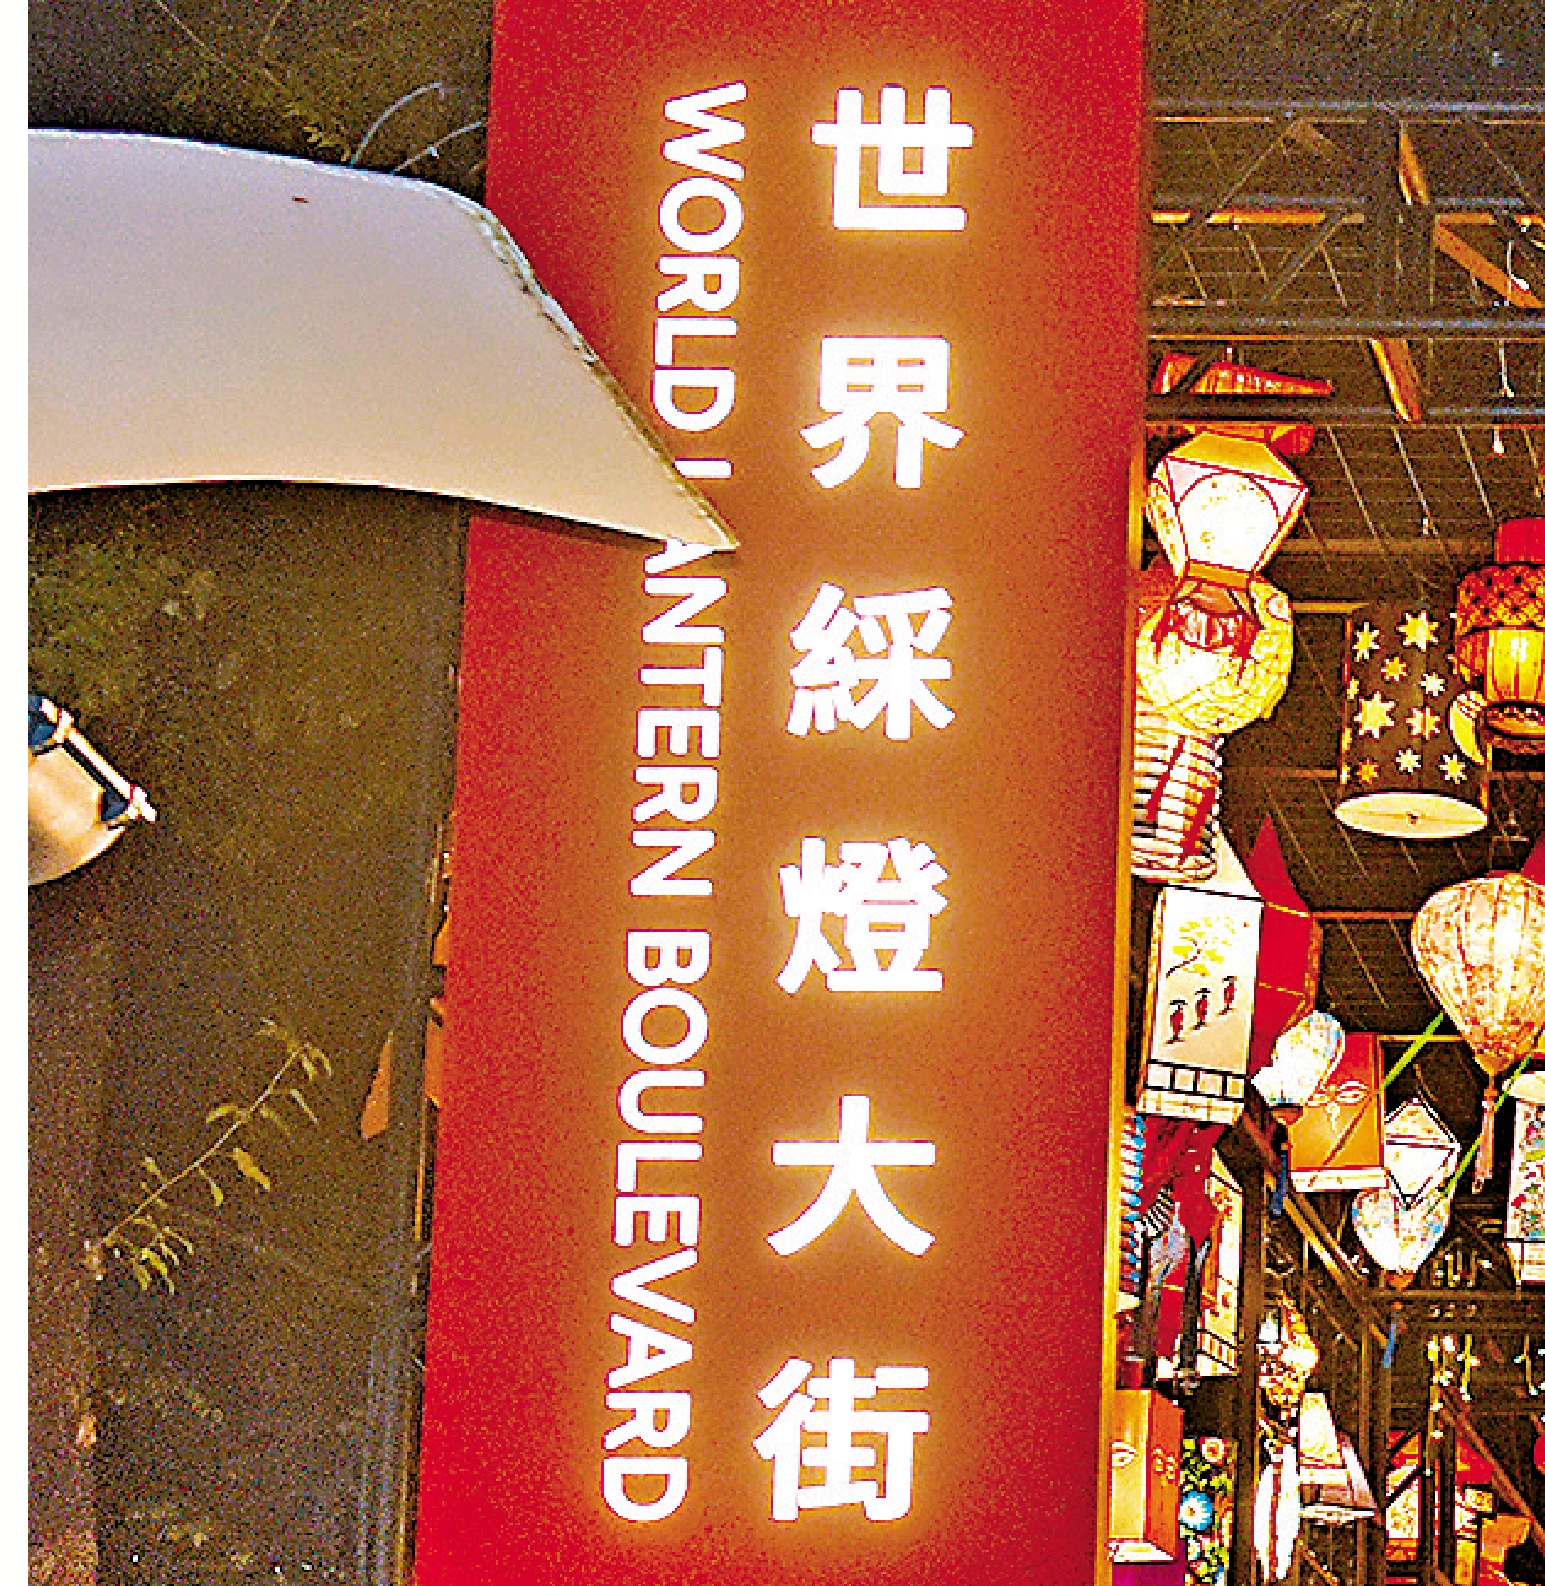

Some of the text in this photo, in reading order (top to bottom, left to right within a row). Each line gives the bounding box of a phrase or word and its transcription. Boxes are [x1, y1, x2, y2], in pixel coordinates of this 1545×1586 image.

[652, 81, 748, 433] WORLD
[751, 86, 975, 1522] 世界綵燈大街
[602, 930, 711, 1522] BOULEVARD
